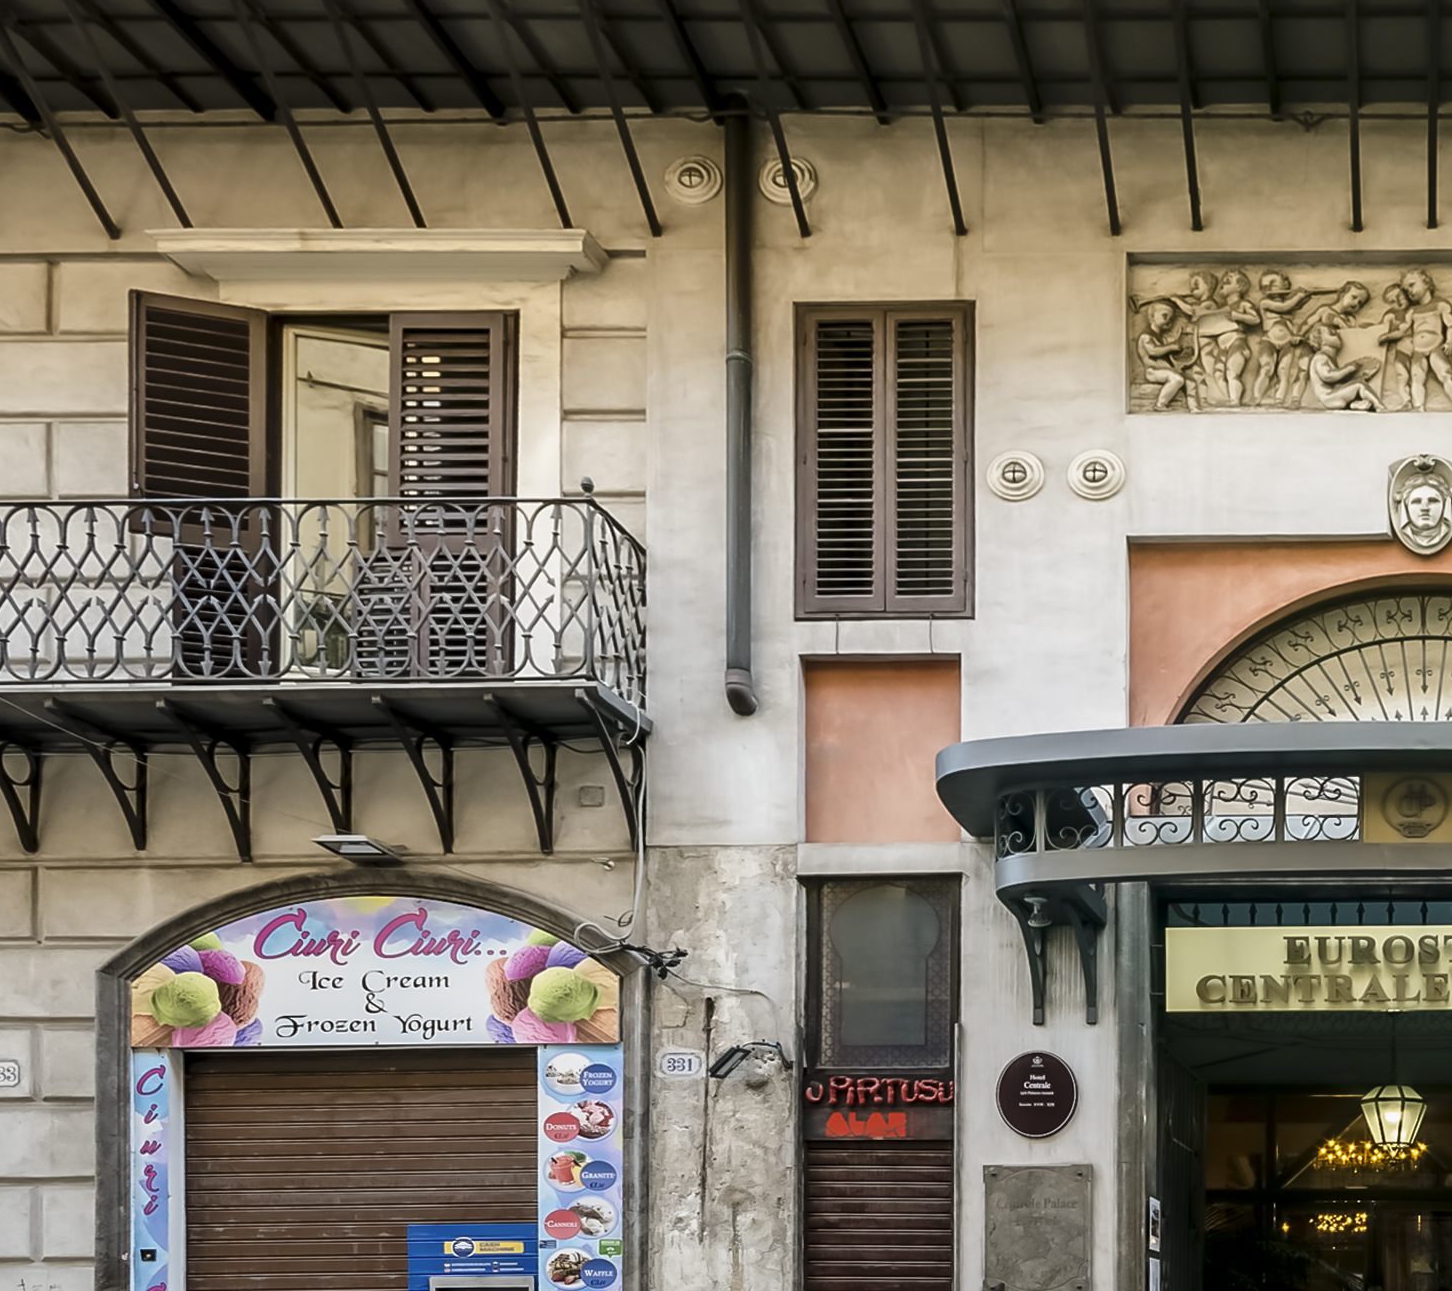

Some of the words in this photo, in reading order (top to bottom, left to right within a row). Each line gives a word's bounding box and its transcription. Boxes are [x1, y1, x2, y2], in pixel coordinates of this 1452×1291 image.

[253, 908, 361, 966] Ciuri
[298, 970, 345, 990] Ice
[361, 970, 450, 994] Cream
[1195, 974, 1450, 1005] CENTRALE
[364, 992, 388, 1014] &
[274, 1015, 376, 1038] Frozen
[393, 1013, 473, 1040] Yogurt
[667, 1057, 692, 1072] 331
